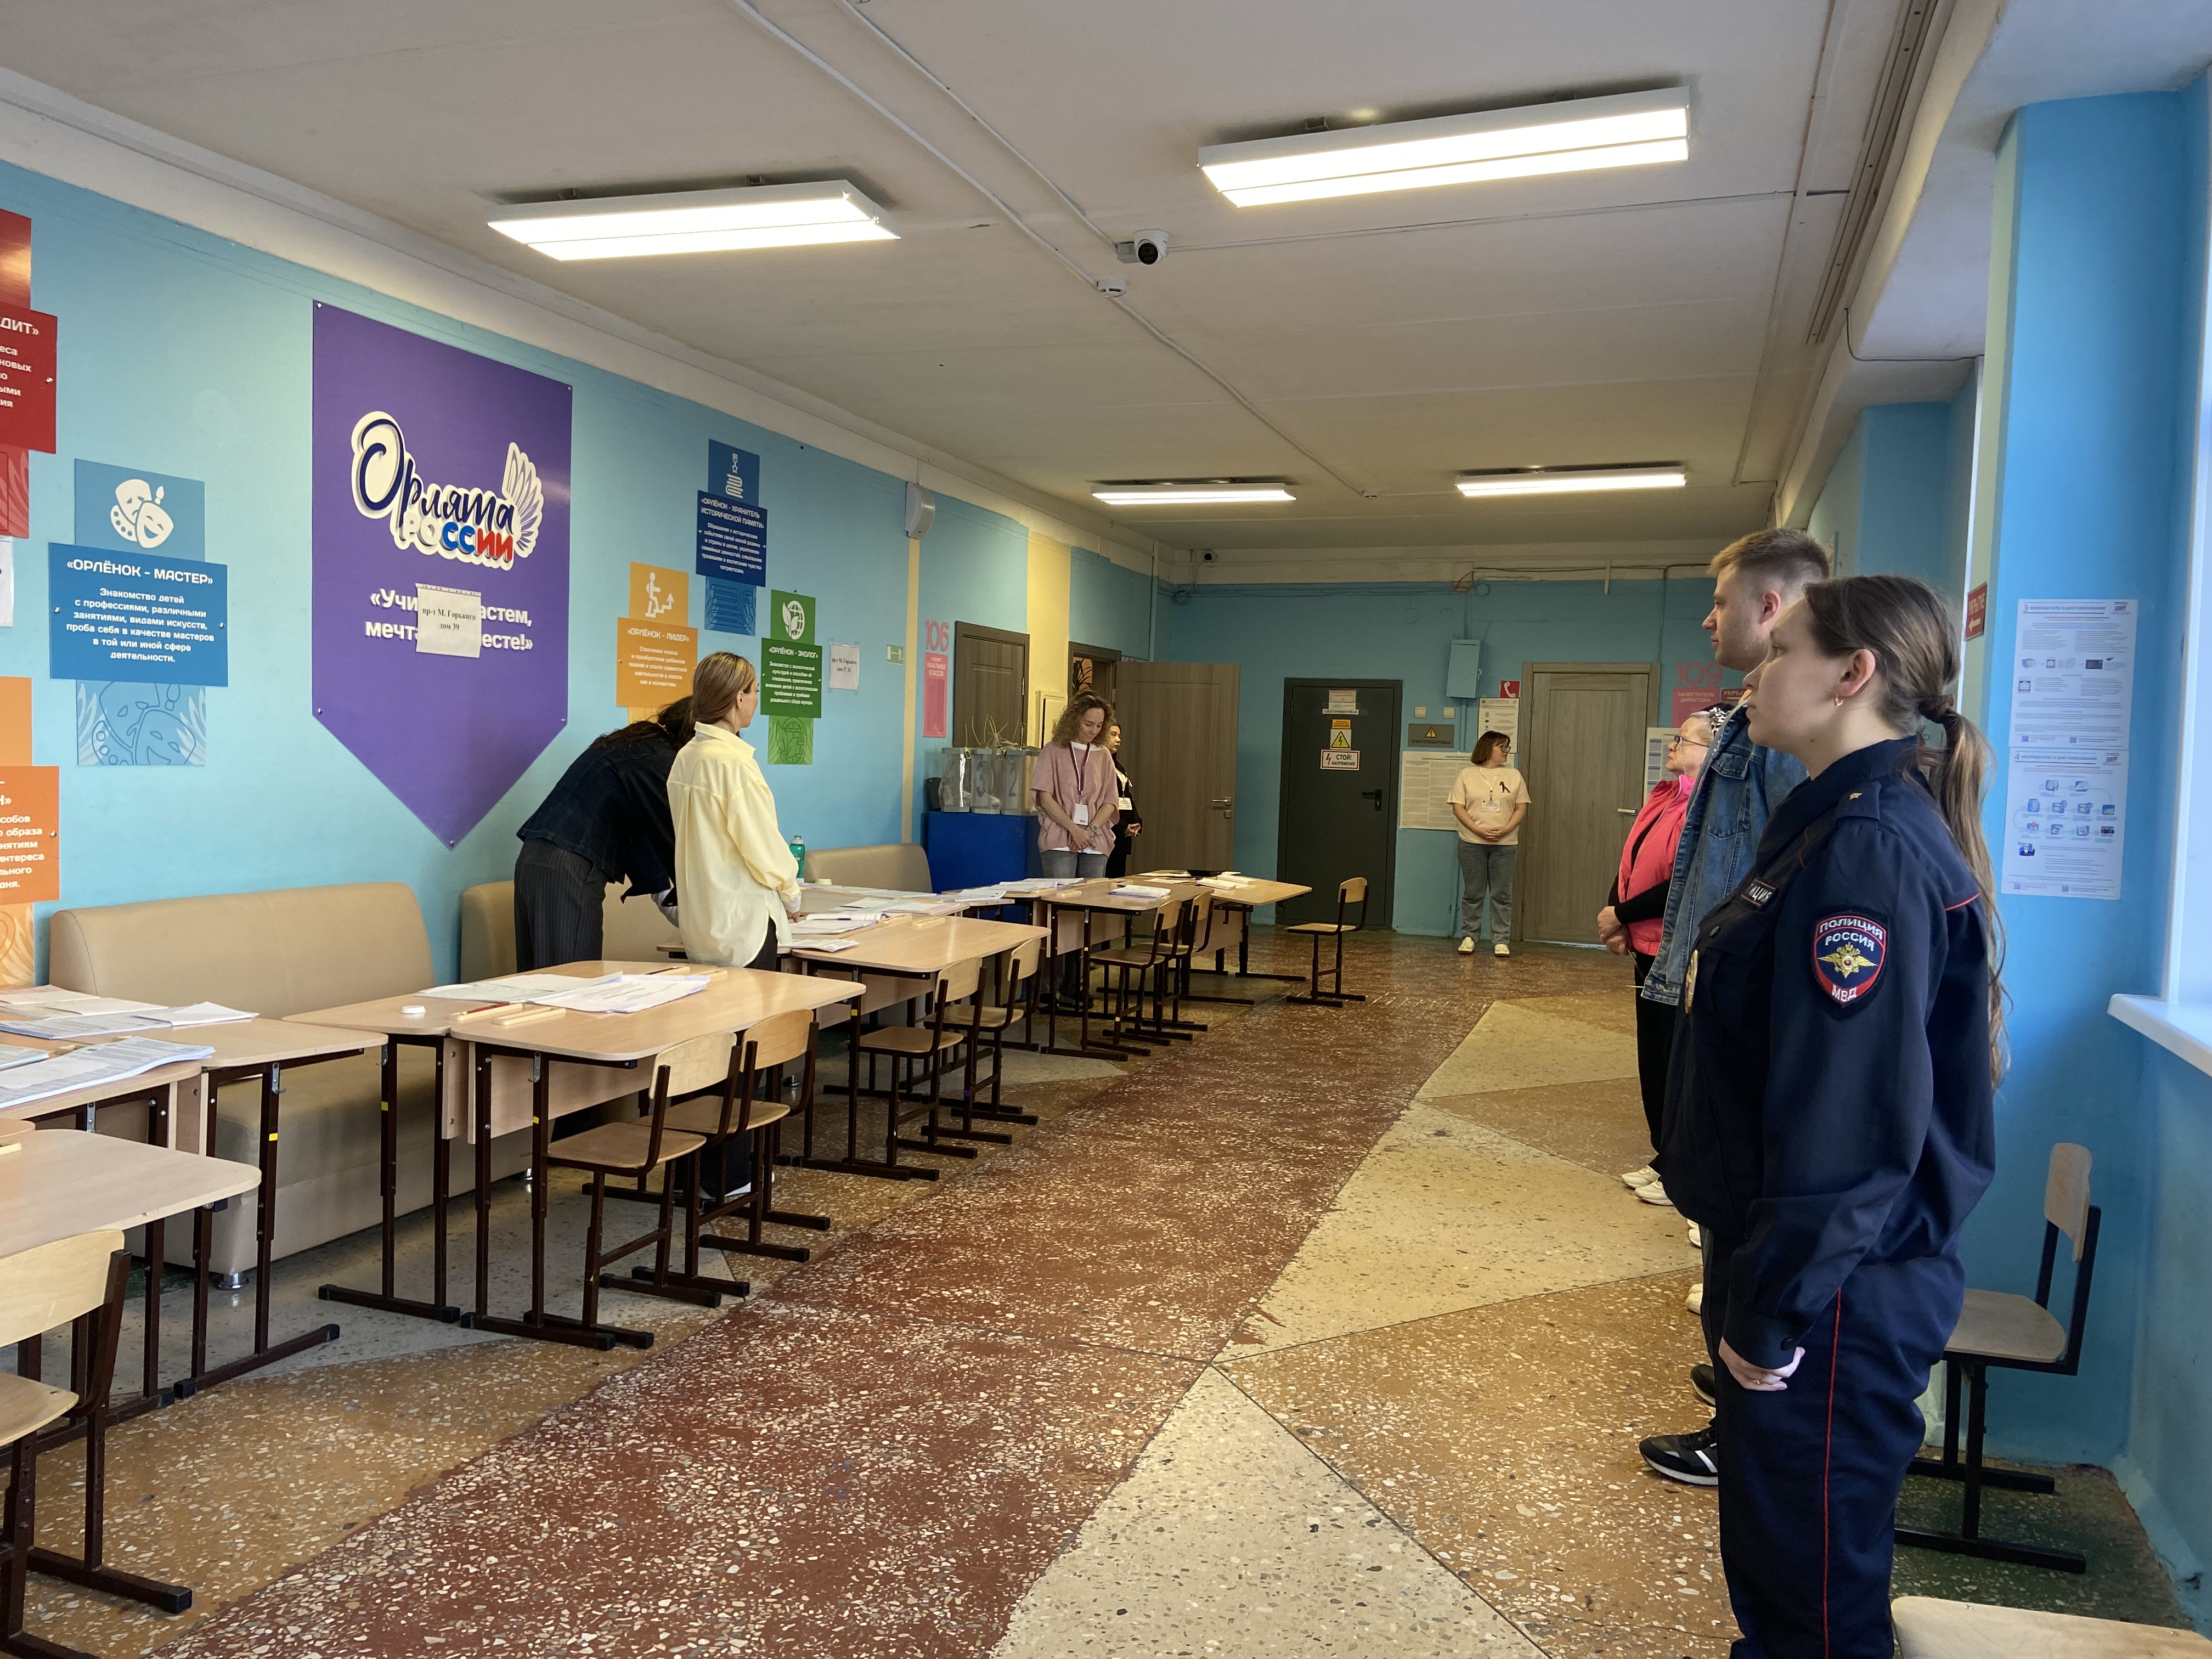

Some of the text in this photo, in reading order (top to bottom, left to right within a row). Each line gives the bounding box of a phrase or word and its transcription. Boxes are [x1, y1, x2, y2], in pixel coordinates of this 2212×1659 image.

[0, 316, 40, 336] ДИТ»
[359, 419, 515, 535] Орлята
[701, 507, 742, 523] ИСТОРИЧЕСКОЙ
[731, 505, 760, 518] ХРАНИТЕЛЬ
[402, 511, 514, 562] РОССИИ
[67, 558, 141, 577] «ОРЛЁНОК
[154, 568, 213, 585] МАСТЕР»
[100, 588, 184, 604] Знакомство детей
[83, 600, 149, 614] профессиями,
[151, 606, 206, 618] различными
[370, 588, 418, 612] «Учи
[481, 605, 532, 627] астем,
[422, 608, 476, 621] пр-т М. Горького
[74, 612, 207, 630] занятиями, видами искусств,
[66, 623, 95, 633] проба
[98, 625, 120, 634] себя
[130, 629, 171, 638] качестве
[173, 632, 215, 642] мастеров
[365, 620, 533, 651] мечт есте!»
[628, 628, 661, 639] «ОРЛЁНОК
[666, 633, 690, 642] ЛИДЕР»
[924, 620, 950, 652] 106
[101, 638, 118, 647] той
[140, 641, 162, 650] иной
[164, 642, 191, 652] сфере
[769, 646, 794, 656] «ОРЛЁНОК
[798, 650, 819, 658] ЭКОЛОГ»
[110, 651, 176, 663] деятельности.
[1675, 662, 1722, 685] 109
[6, 827, 43, 837] образа
[1748, 883, 1772, 903] ИЦИЯ
[1819, 918, 1883, 941] ПОЛИЦИЯ
[1825, 932, 1875, 952] РОССИЯ
[1832, 984, 1858, 1002] МВД
